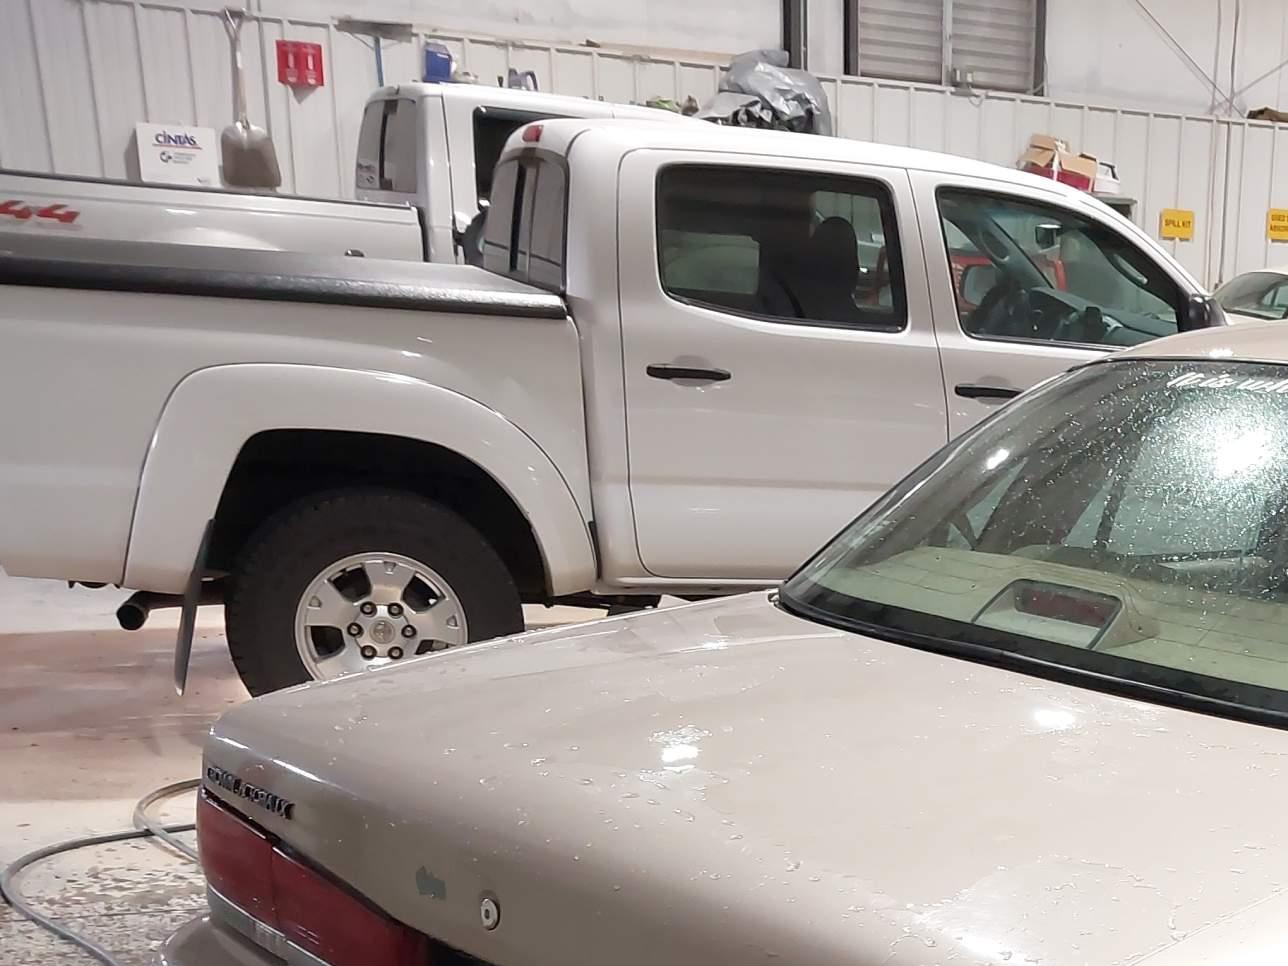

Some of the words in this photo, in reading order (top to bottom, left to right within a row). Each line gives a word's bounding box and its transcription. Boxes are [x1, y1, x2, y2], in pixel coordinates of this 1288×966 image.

[0, 199, 81, 224] 44
[1164, 219, 1180, 228] SPILL
[1181, 220, 1191, 228] KIT
